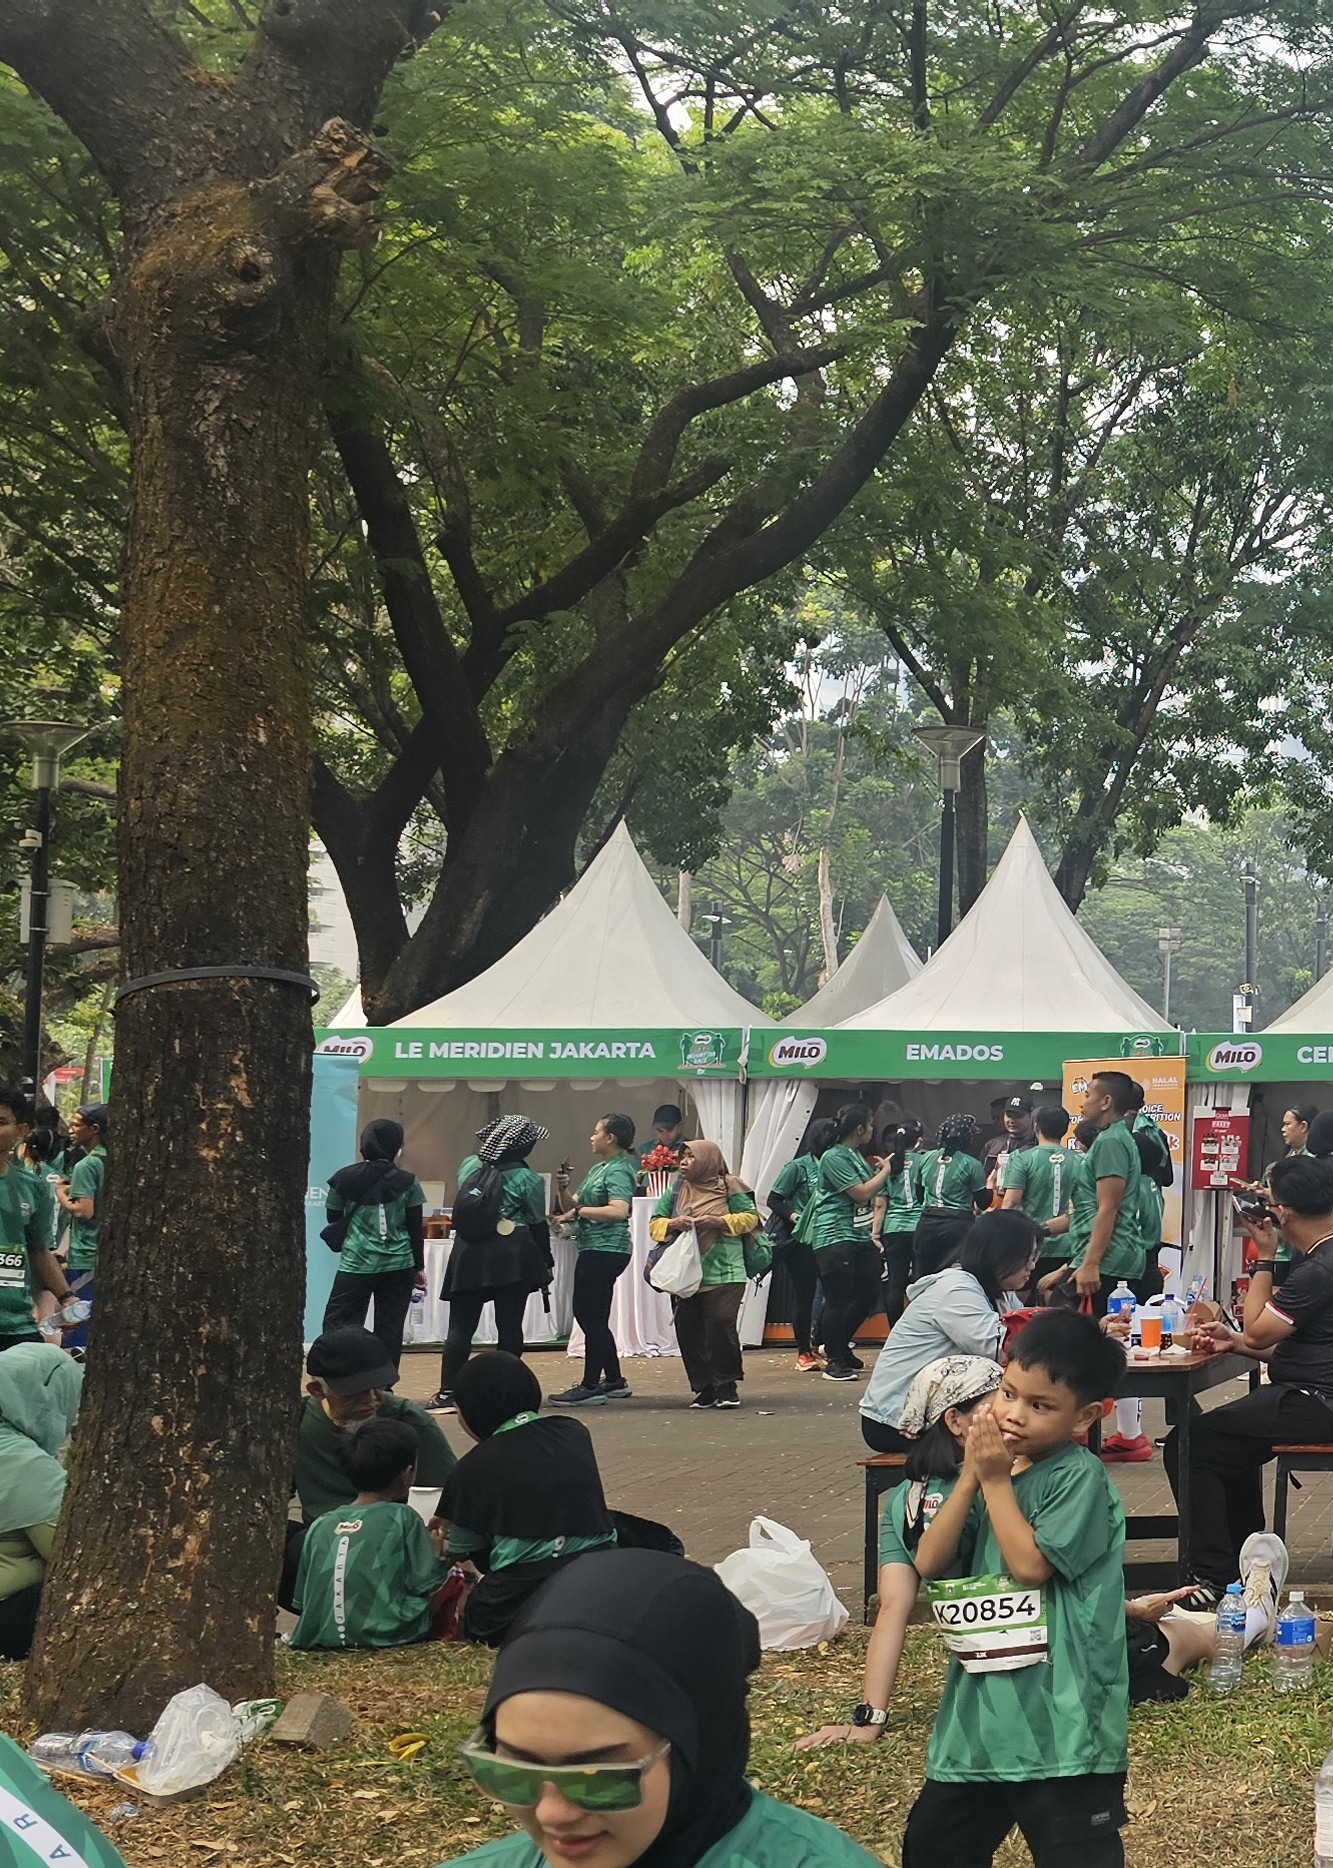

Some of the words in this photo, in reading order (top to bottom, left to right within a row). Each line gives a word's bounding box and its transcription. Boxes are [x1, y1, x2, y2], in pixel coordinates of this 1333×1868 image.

[395, 1042, 422, 1059] LE
[428, 1042, 544, 1059] MERIDIEN
[549, 1042, 656, 1059] JAKARTA
[778, 1044, 821, 1059] MILO
[906, 1044, 1004, 1061] EMADOS
[1214, 1048, 1256, 1064] MILO
[1141, 1104, 1164, 1113] OICE
[935, 1595, 1036, 1625] K20854
